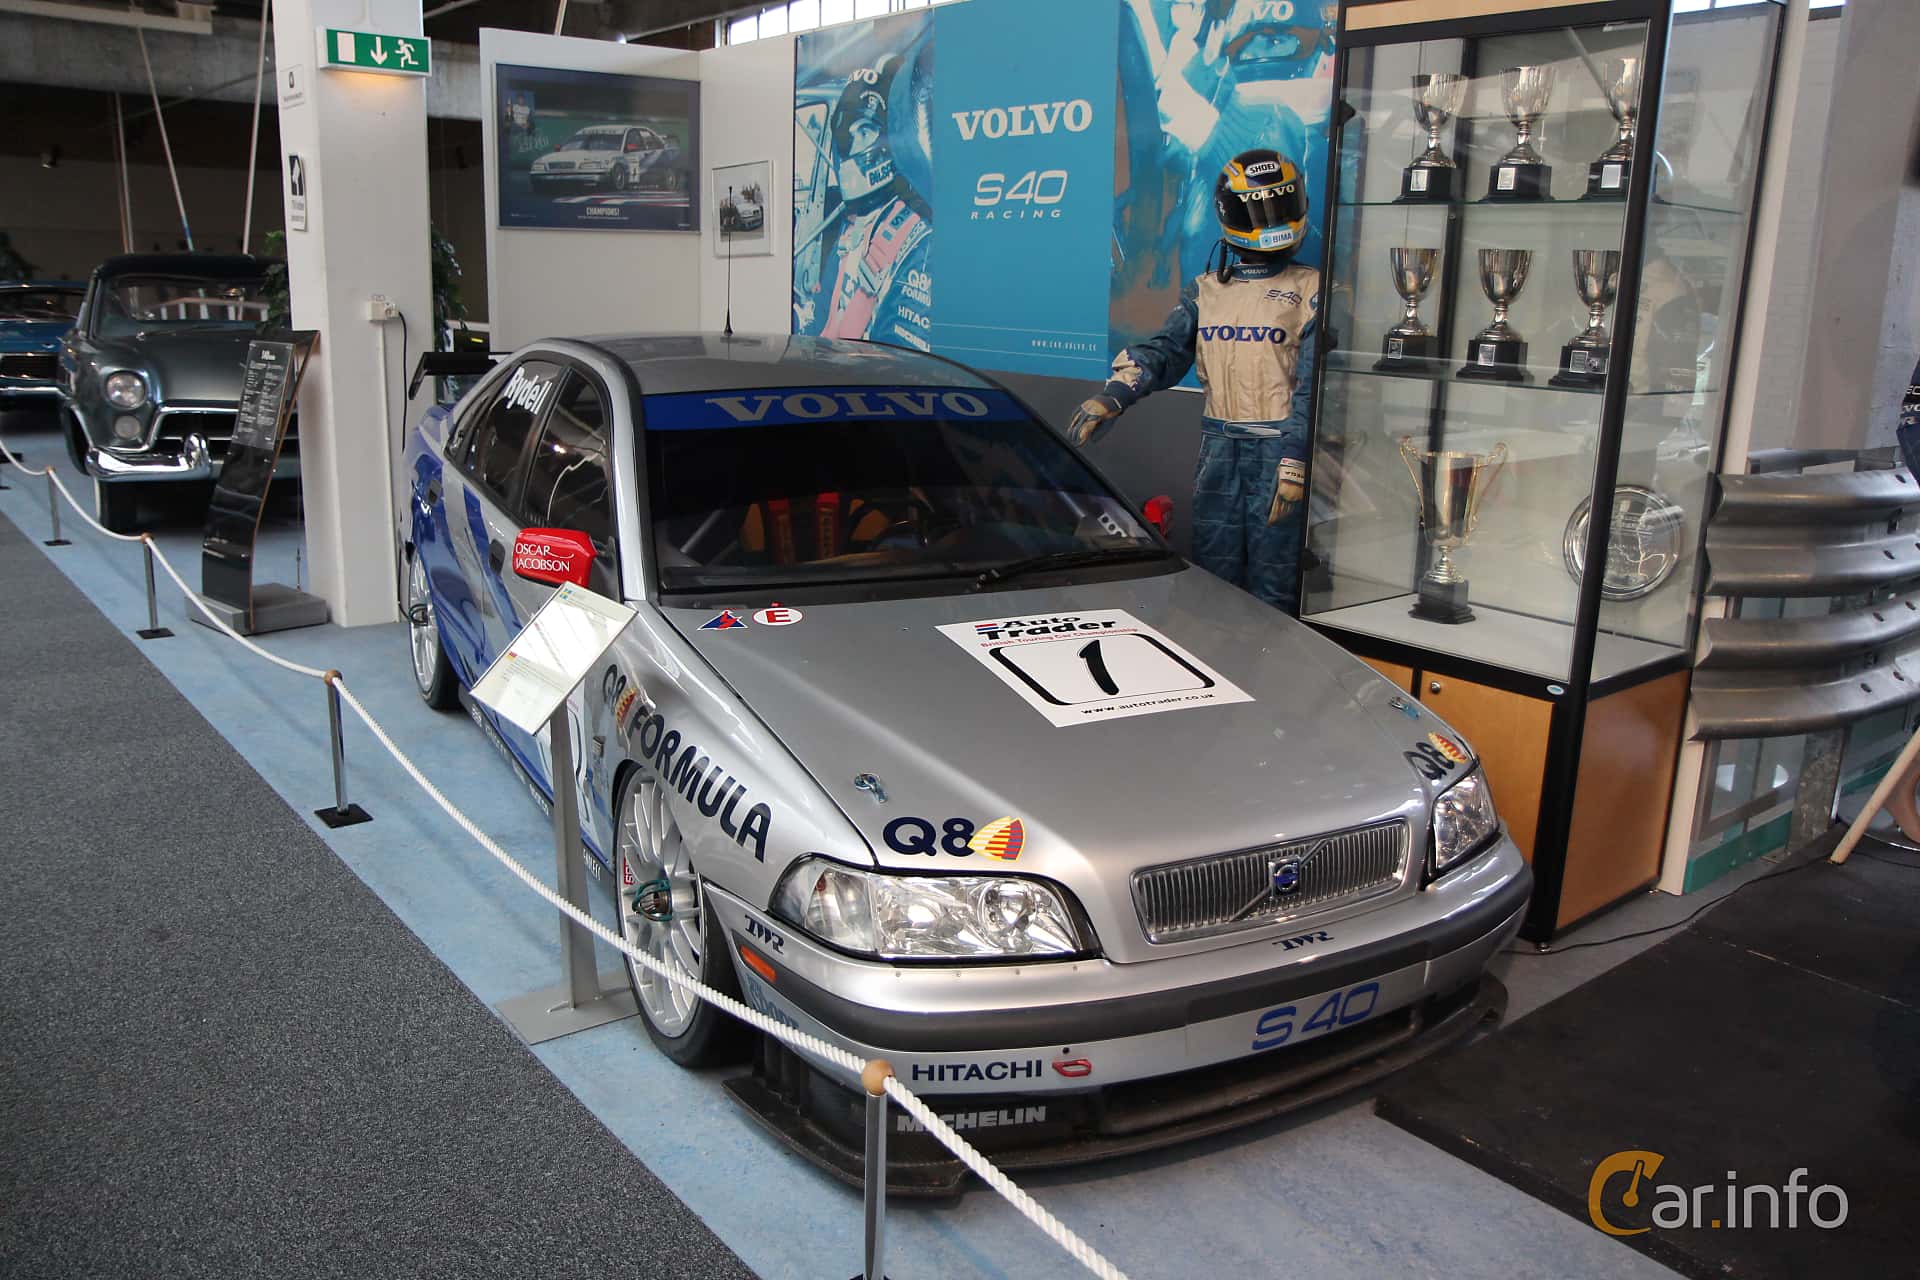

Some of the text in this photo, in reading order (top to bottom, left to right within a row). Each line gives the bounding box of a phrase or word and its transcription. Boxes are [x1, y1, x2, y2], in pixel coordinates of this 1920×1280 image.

[952, 99, 1093, 141] VOLVO
[1249, 162, 1276, 174] SHOEI
[974, 169, 1068, 207] S40
[1236, 185, 1296, 203] VOLVO
[970, 209, 1063, 221] RACING
[1199, 325, 1287, 344] VOLVO
[504, 366, 553, 416] Rydell
[705, 391, 989, 422] VOLVO
[515, 542, 559, 558] OSCAR
[515, 558, 571, 573] JACOBSON
[977, 621, 1117, 641] Trader
[1001, 615, 1081, 629] Auto
[1079, 639, 1120, 696] 1
[1080, 693, 1215, 715] www.autotrader.co.uk
[628, 705, 772, 864] FORMULA
[882, 816, 976, 858] Q8
[1272, 930, 1335, 952] TWR
[1250, 982, 1380, 1051] S40
[912, 1058, 1043, 1083] HITACHI
[896, 1105, 1048, 1133] MCHELIN
